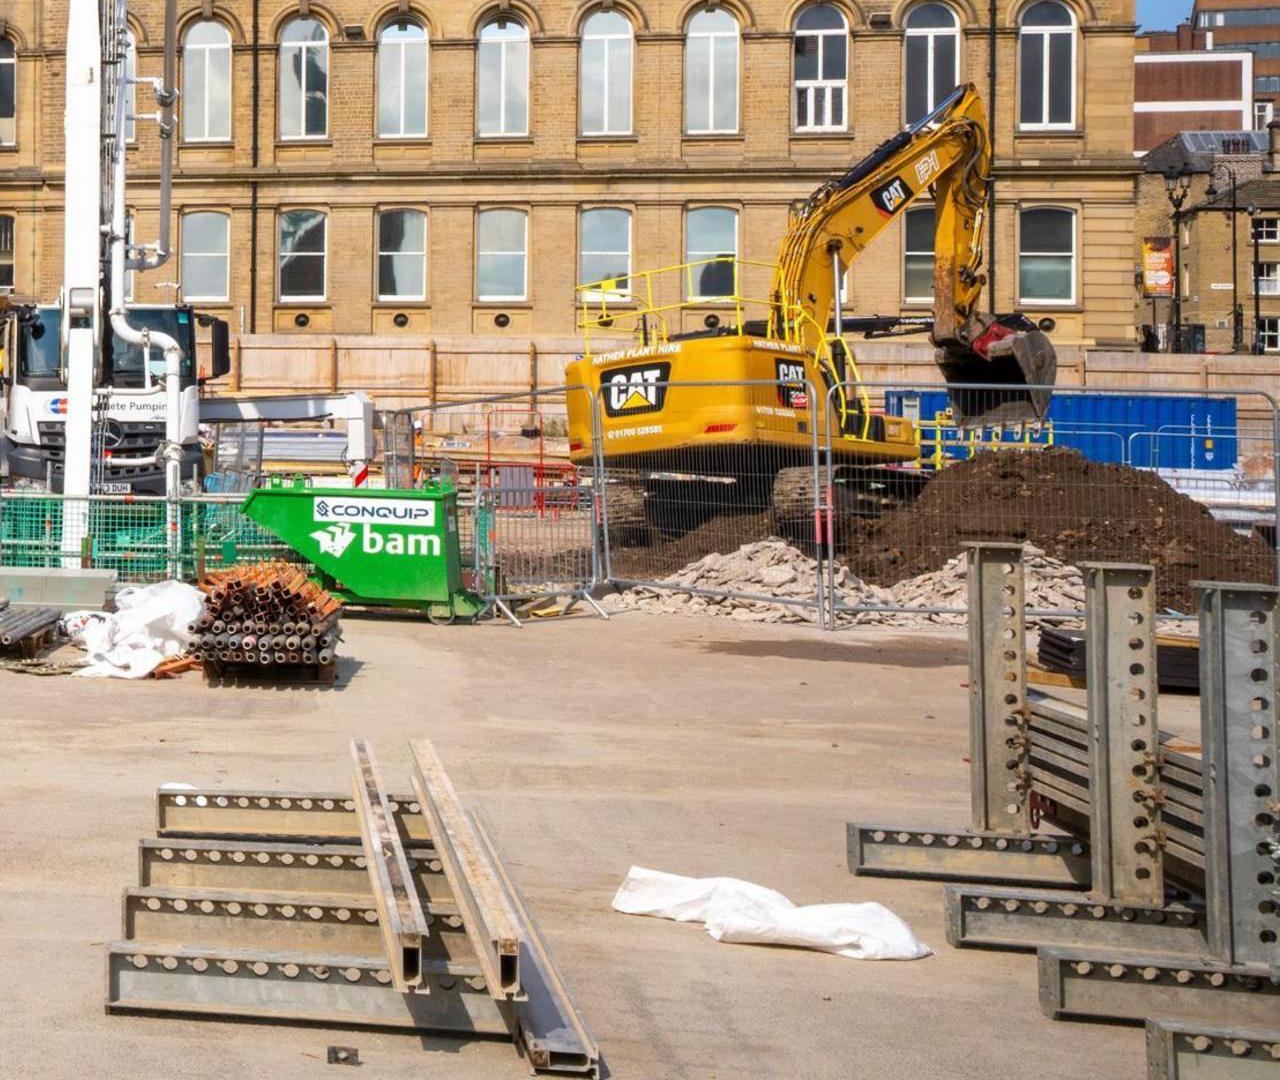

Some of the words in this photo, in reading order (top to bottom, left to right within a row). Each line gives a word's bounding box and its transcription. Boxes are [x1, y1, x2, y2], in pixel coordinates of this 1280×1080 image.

[881, 179, 906, 212] CAT
[626, 346, 656, 359] PLANT
[779, 363, 804, 388] CAT
[610, 369, 661, 410] CAT
[129, 402, 167, 411] Pumpin
[332, 505, 429, 519] CONQUIP
[362, 523, 441, 556] bam
